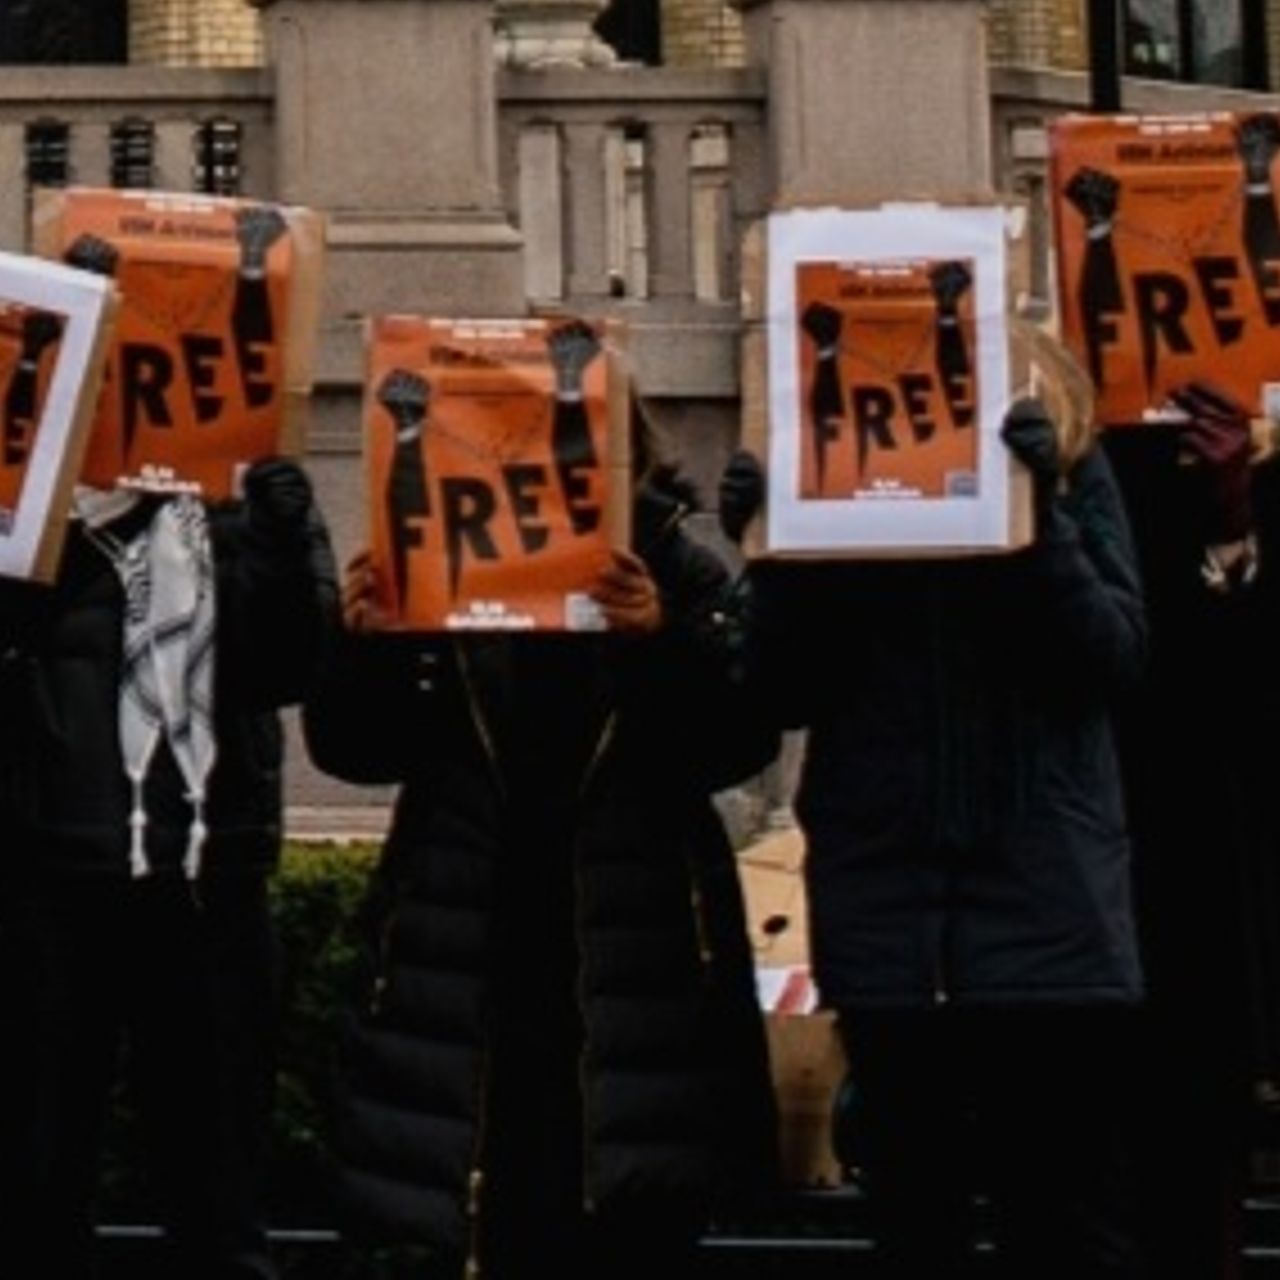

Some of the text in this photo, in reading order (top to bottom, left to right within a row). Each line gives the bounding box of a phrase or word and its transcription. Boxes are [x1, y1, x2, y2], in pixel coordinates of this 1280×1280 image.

[104, 328, 274, 466] REE
[814, 362, 973, 496] FREE
[387, 450, 601, 620] FREE
